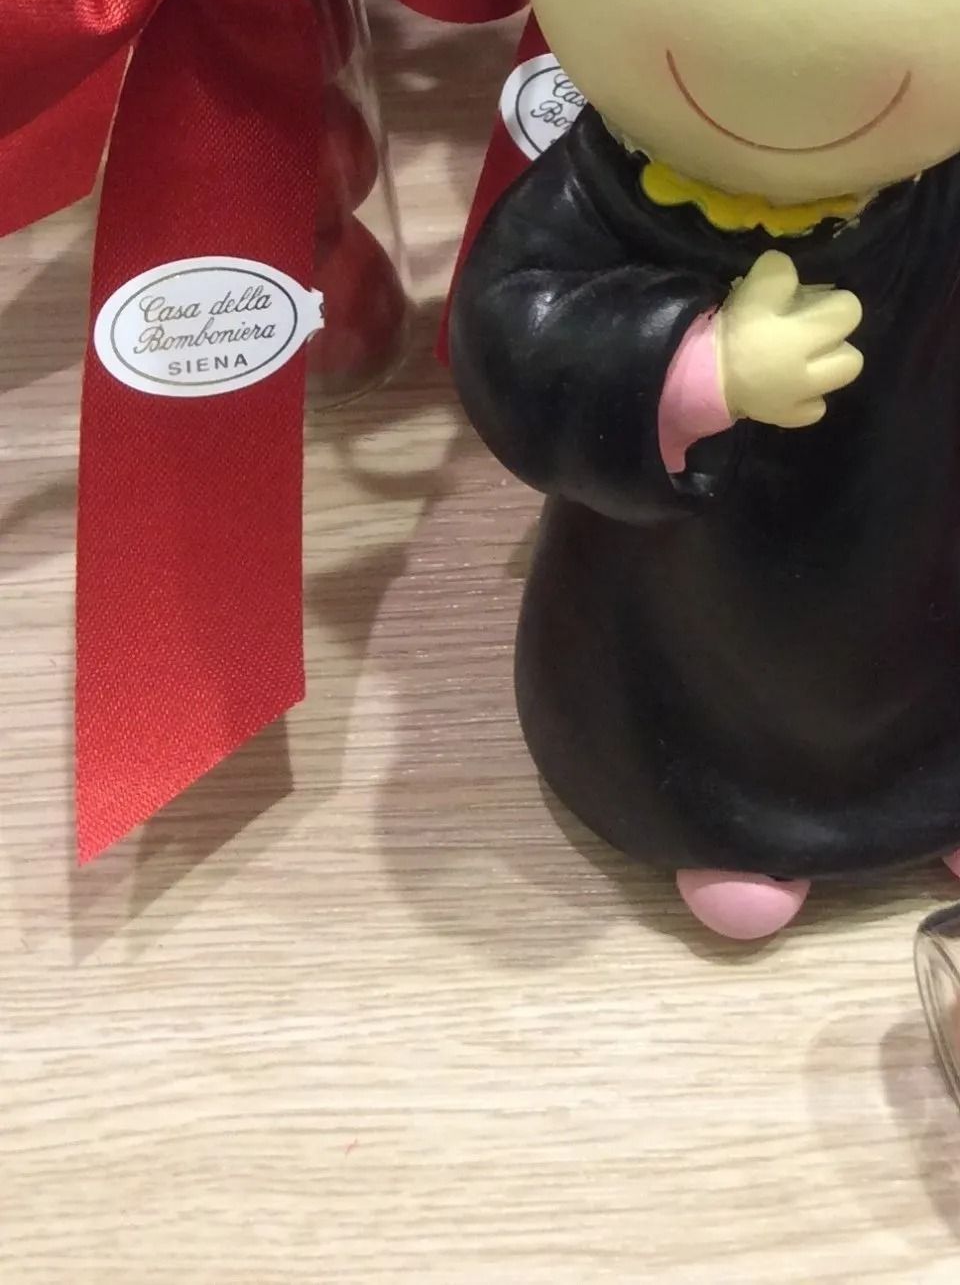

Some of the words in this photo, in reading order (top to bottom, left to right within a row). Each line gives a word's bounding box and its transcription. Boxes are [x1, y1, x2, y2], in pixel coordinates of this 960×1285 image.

[553, 73, 585, 107] Cas
[139, 294, 200, 323] Casa
[207, 284, 272, 316] della
[133, 317, 276, 354] Bomboniera
[168, 353, 248, 376] SIENA
